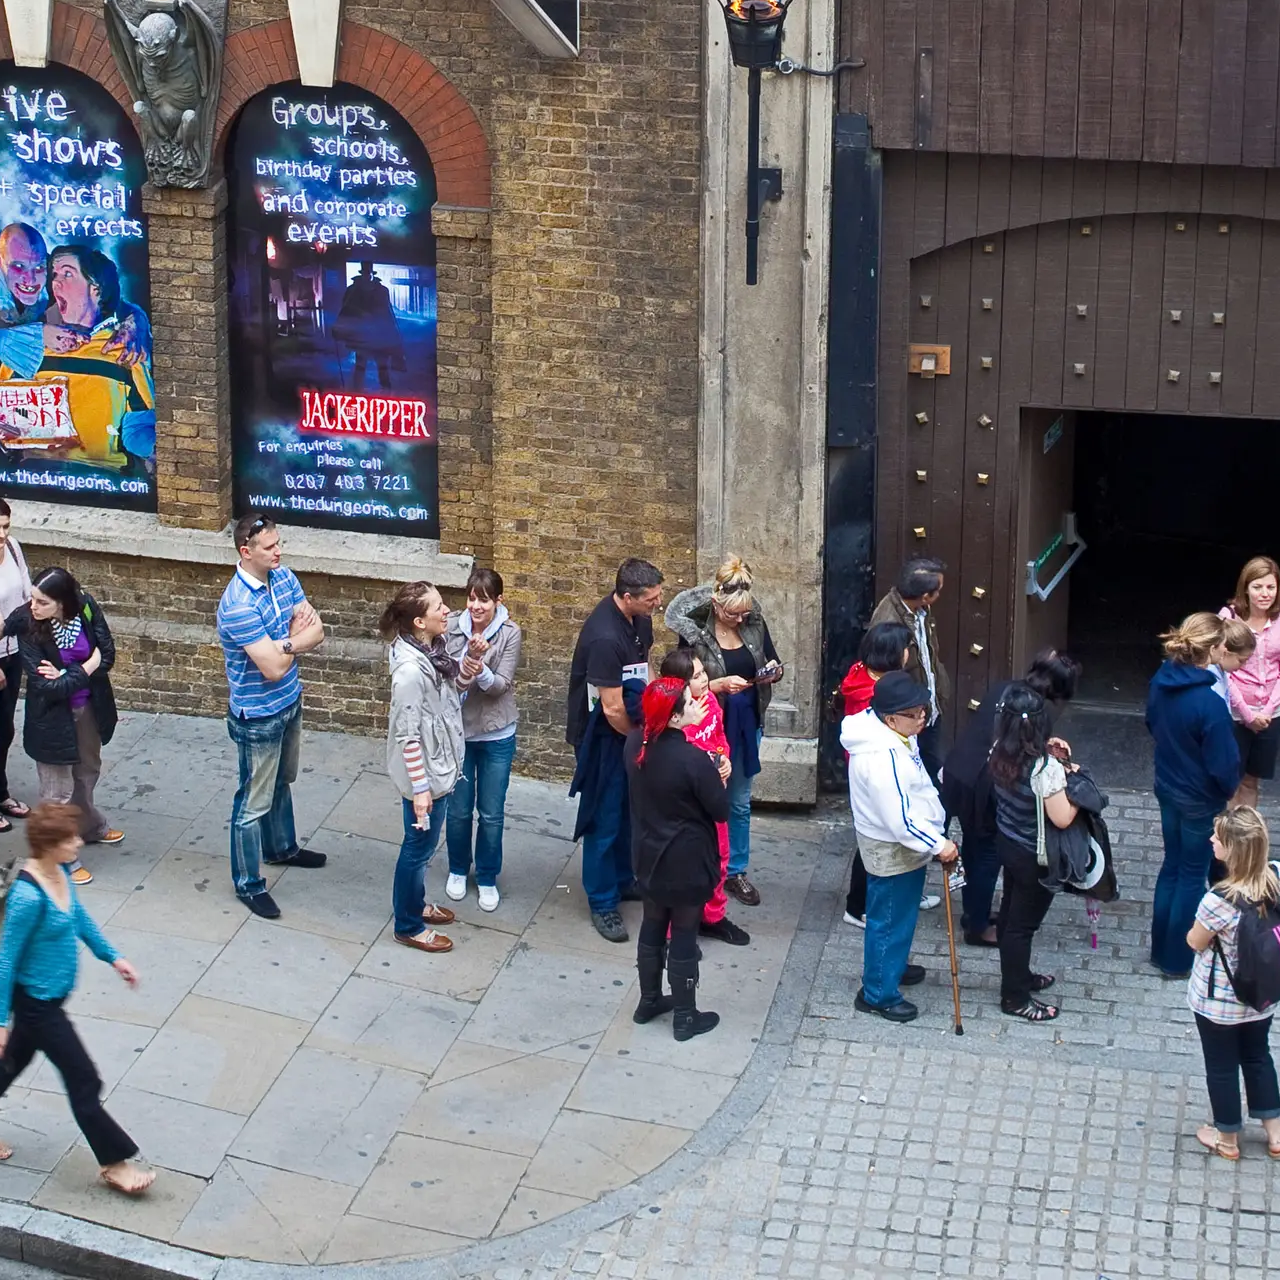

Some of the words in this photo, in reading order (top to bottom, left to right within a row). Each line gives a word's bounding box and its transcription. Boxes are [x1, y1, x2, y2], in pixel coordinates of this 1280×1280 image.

[271, 96, 390, 136] Groups,
[11, 128, 124, 170] shows
[310, 135, 410, 166] schools,
[256, 157, 332, 183] birthday
[339, 166, 417, 191] parties
[26, 182, 128, 212] special
[263, 190, 308, 214] and
[314, 198, 408, 221] corporate
[56, 215, 143, 238] effects
[287, 222, 377, 247] events
[302, 391, 353, 431] JACK
[345, 406, 357, 418] THE
[354, 395, 430, 437] RIPPER
[258, 440, 281, 453] For
[286, 439, 344, 455] enquiries
[317, 453, 356, 468] please
[284, 473, 325, 490] 0207
[334, 474, 365, 491] 403
[374, 475, 411, 491] 7221
